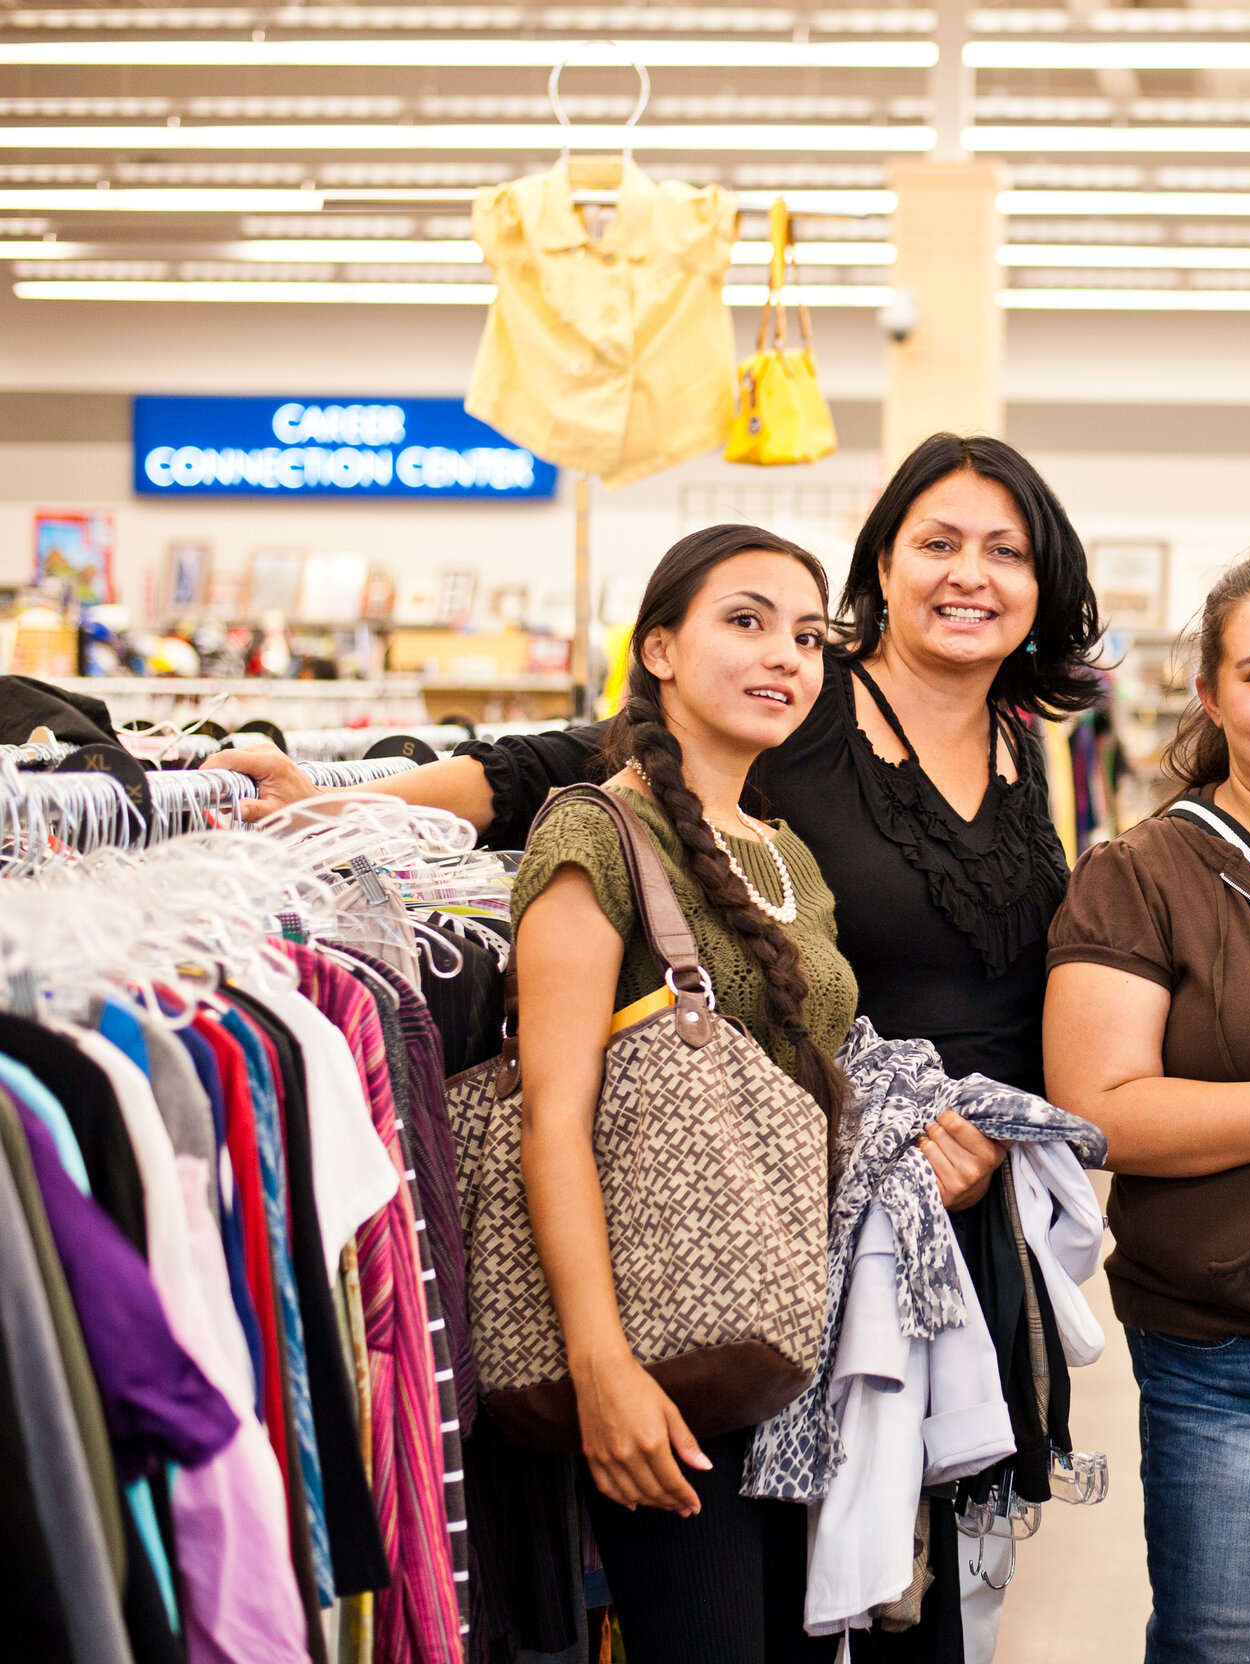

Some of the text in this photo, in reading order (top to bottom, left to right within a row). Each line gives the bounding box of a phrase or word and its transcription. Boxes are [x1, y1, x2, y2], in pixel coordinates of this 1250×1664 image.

[272, 403, 406, 446] CAREER
[144, 445, 535, 490] CONNECTION CENTER
[83, 753, 111, 771] XL
[402, 741, 415, 756] S
